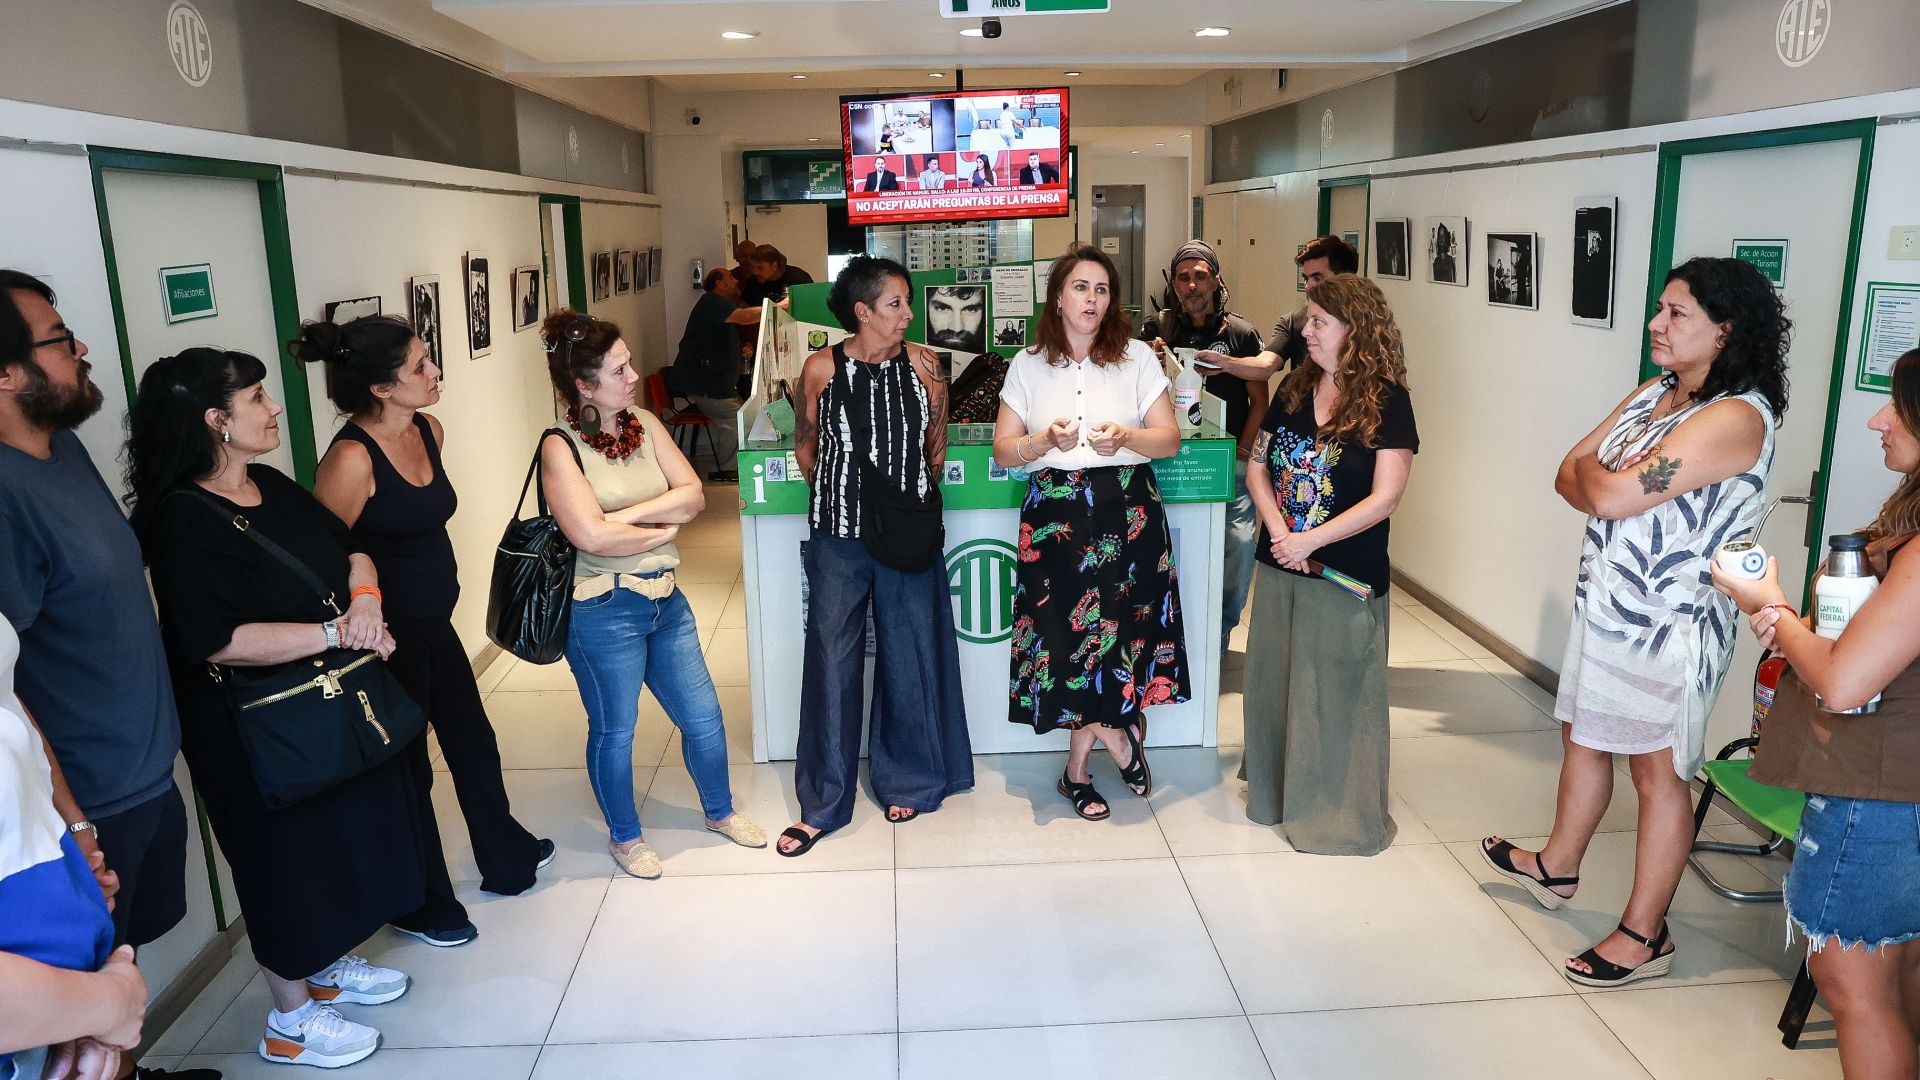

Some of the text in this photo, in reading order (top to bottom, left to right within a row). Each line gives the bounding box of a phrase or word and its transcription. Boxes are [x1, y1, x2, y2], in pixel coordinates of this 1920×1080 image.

[1780, 0, 1825, 60] ATE
[171, 7, 209, 80] ATE
[856, 192, 1060, 212] NO ACEPTARÁN PREGUNTAS DE LA PRENSA
[1752, 249, 1760, 257] de
[1757, 260, 1778, 268] Turismo
[174, 288, 206, 299] Afiliaciones
[1820, 604, 1844, 614] CAPITAL
[1820, 612, 1846, 622] FEDERAL
